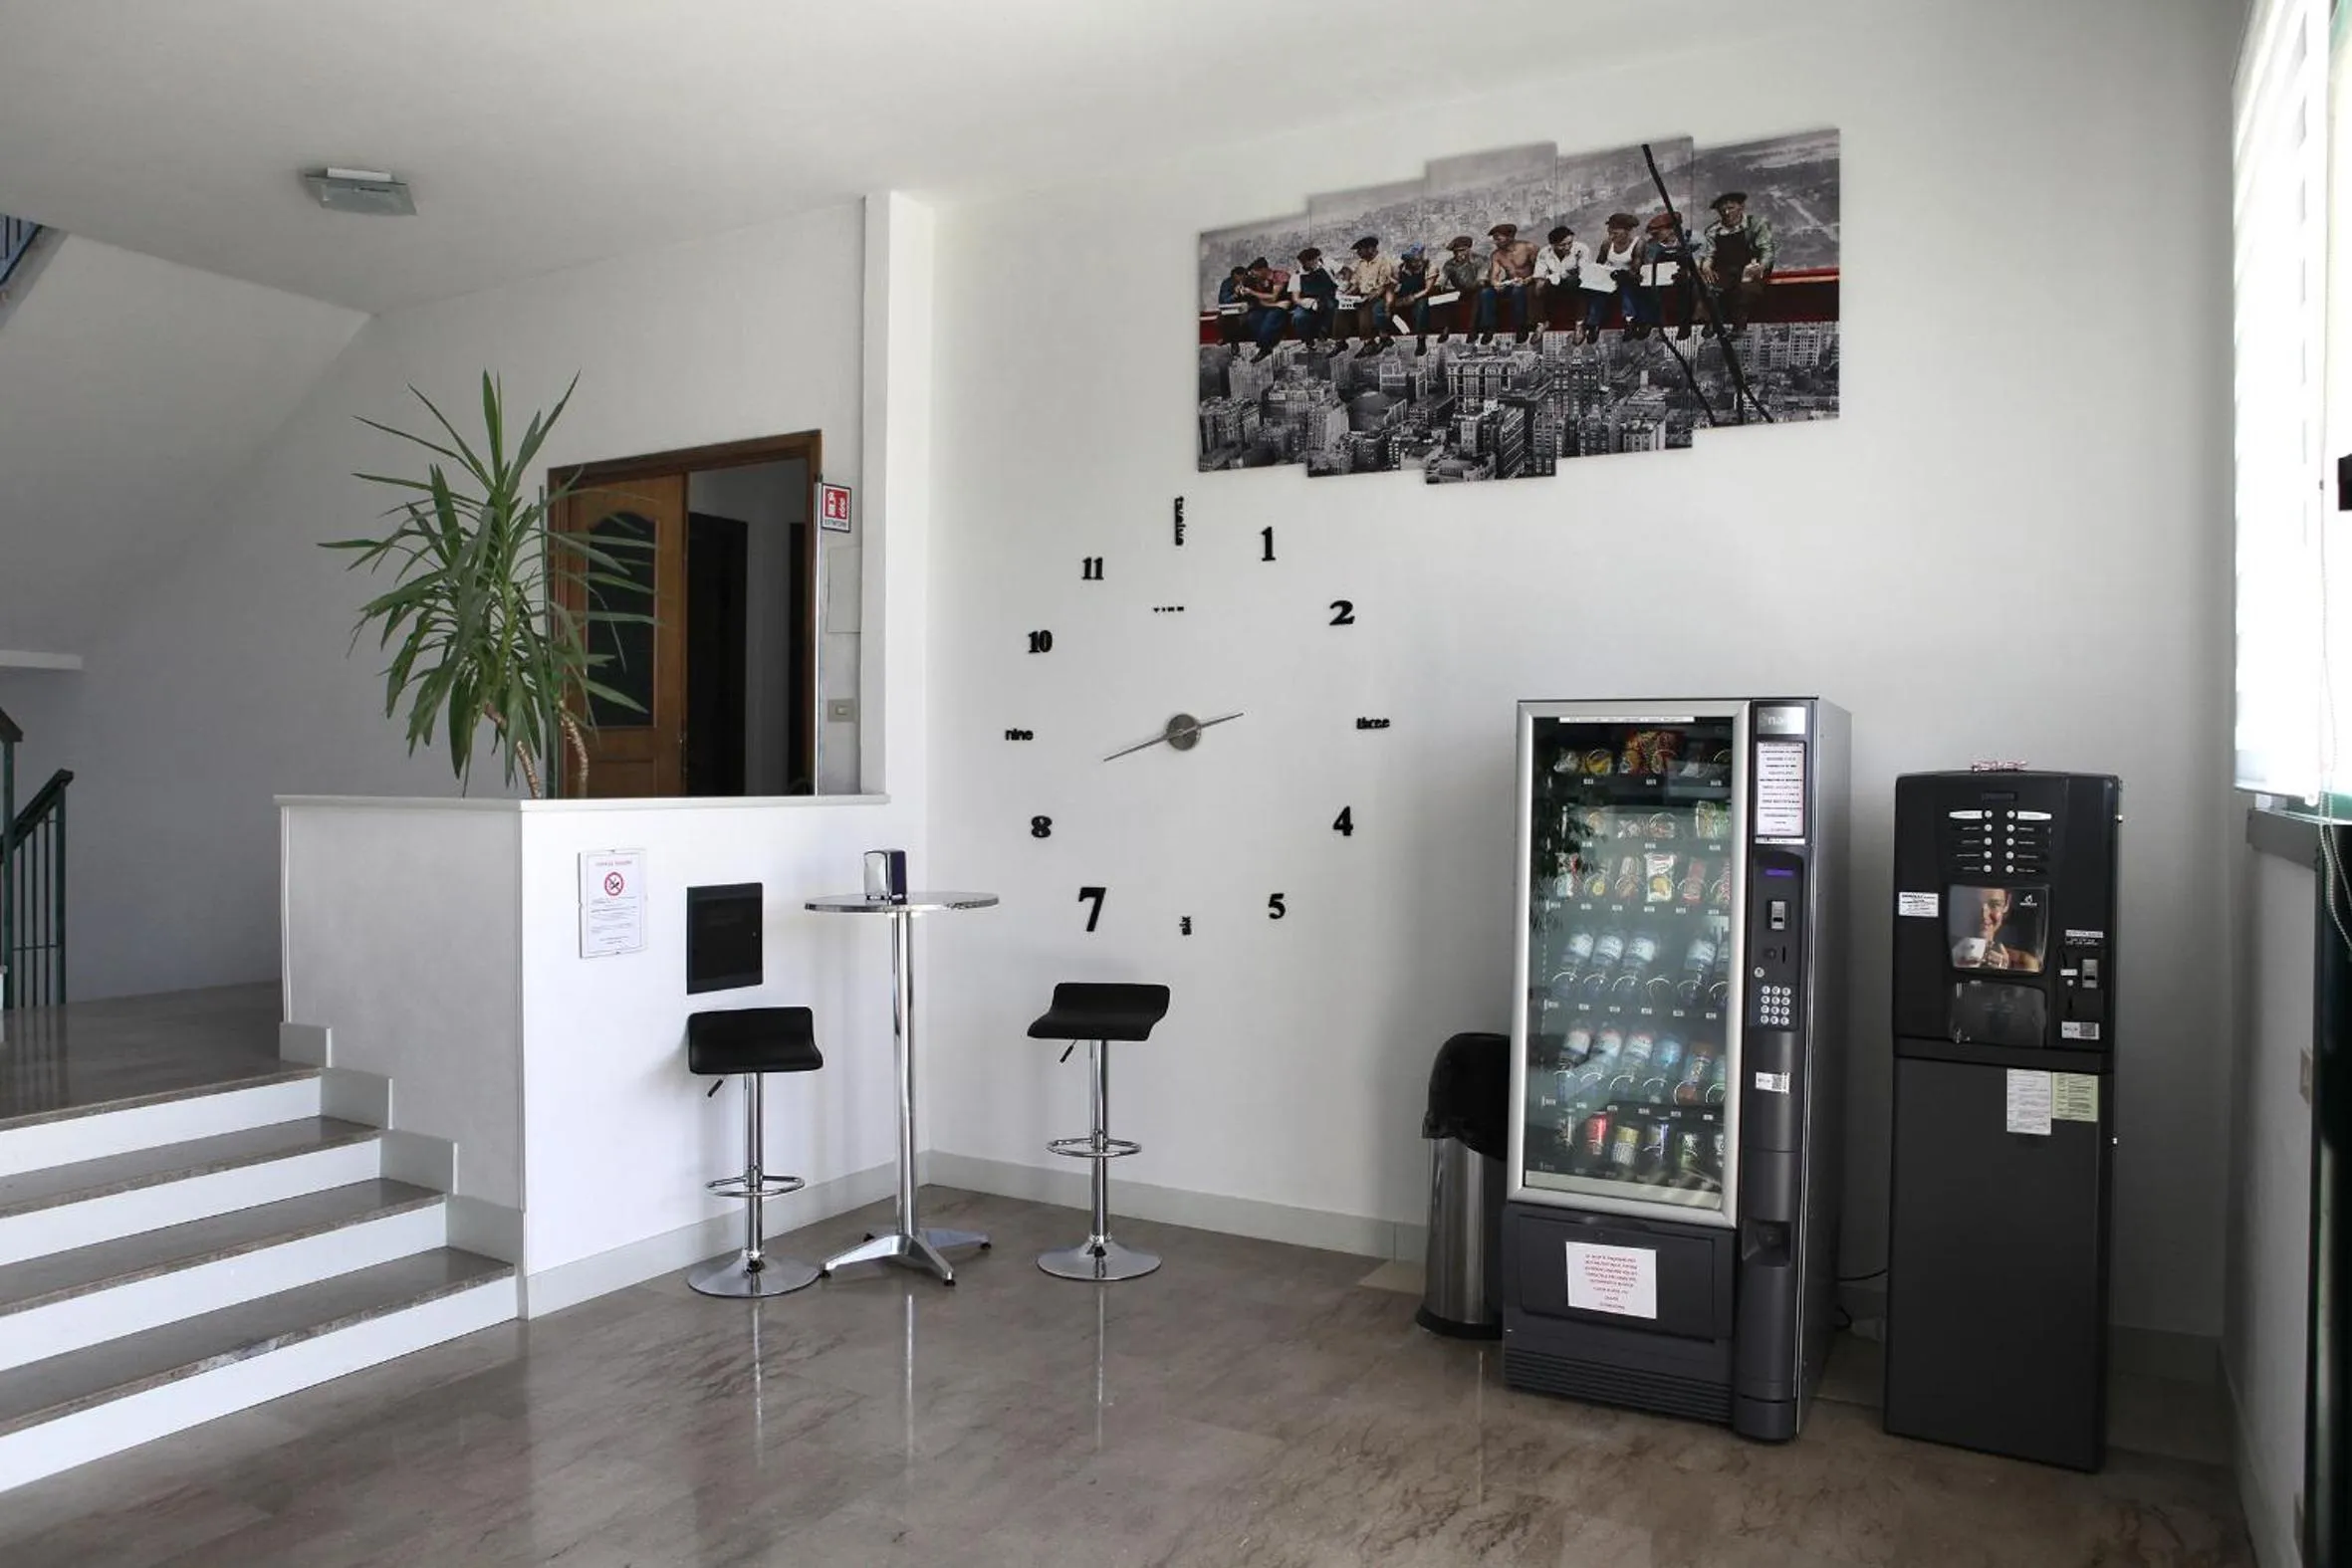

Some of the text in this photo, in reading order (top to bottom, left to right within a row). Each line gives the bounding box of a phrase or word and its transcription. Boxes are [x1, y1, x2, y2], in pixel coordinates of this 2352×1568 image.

[1261, 526, 1277, 562] 1
[1081, 557, 1104, 581] 11
[1328, 599, 1355, 626] 2
[1028, 629, 1054, 654] 10
[1005, 728, 1035, 742] nine
[1355, 716, 1391, 731] three
[1031, 814, 1053, 839] 8
[1332, 805, 1354, 837] 4
[1077, 886, 1107, 933] 7
[1268, 892, 1287, 920] 5
